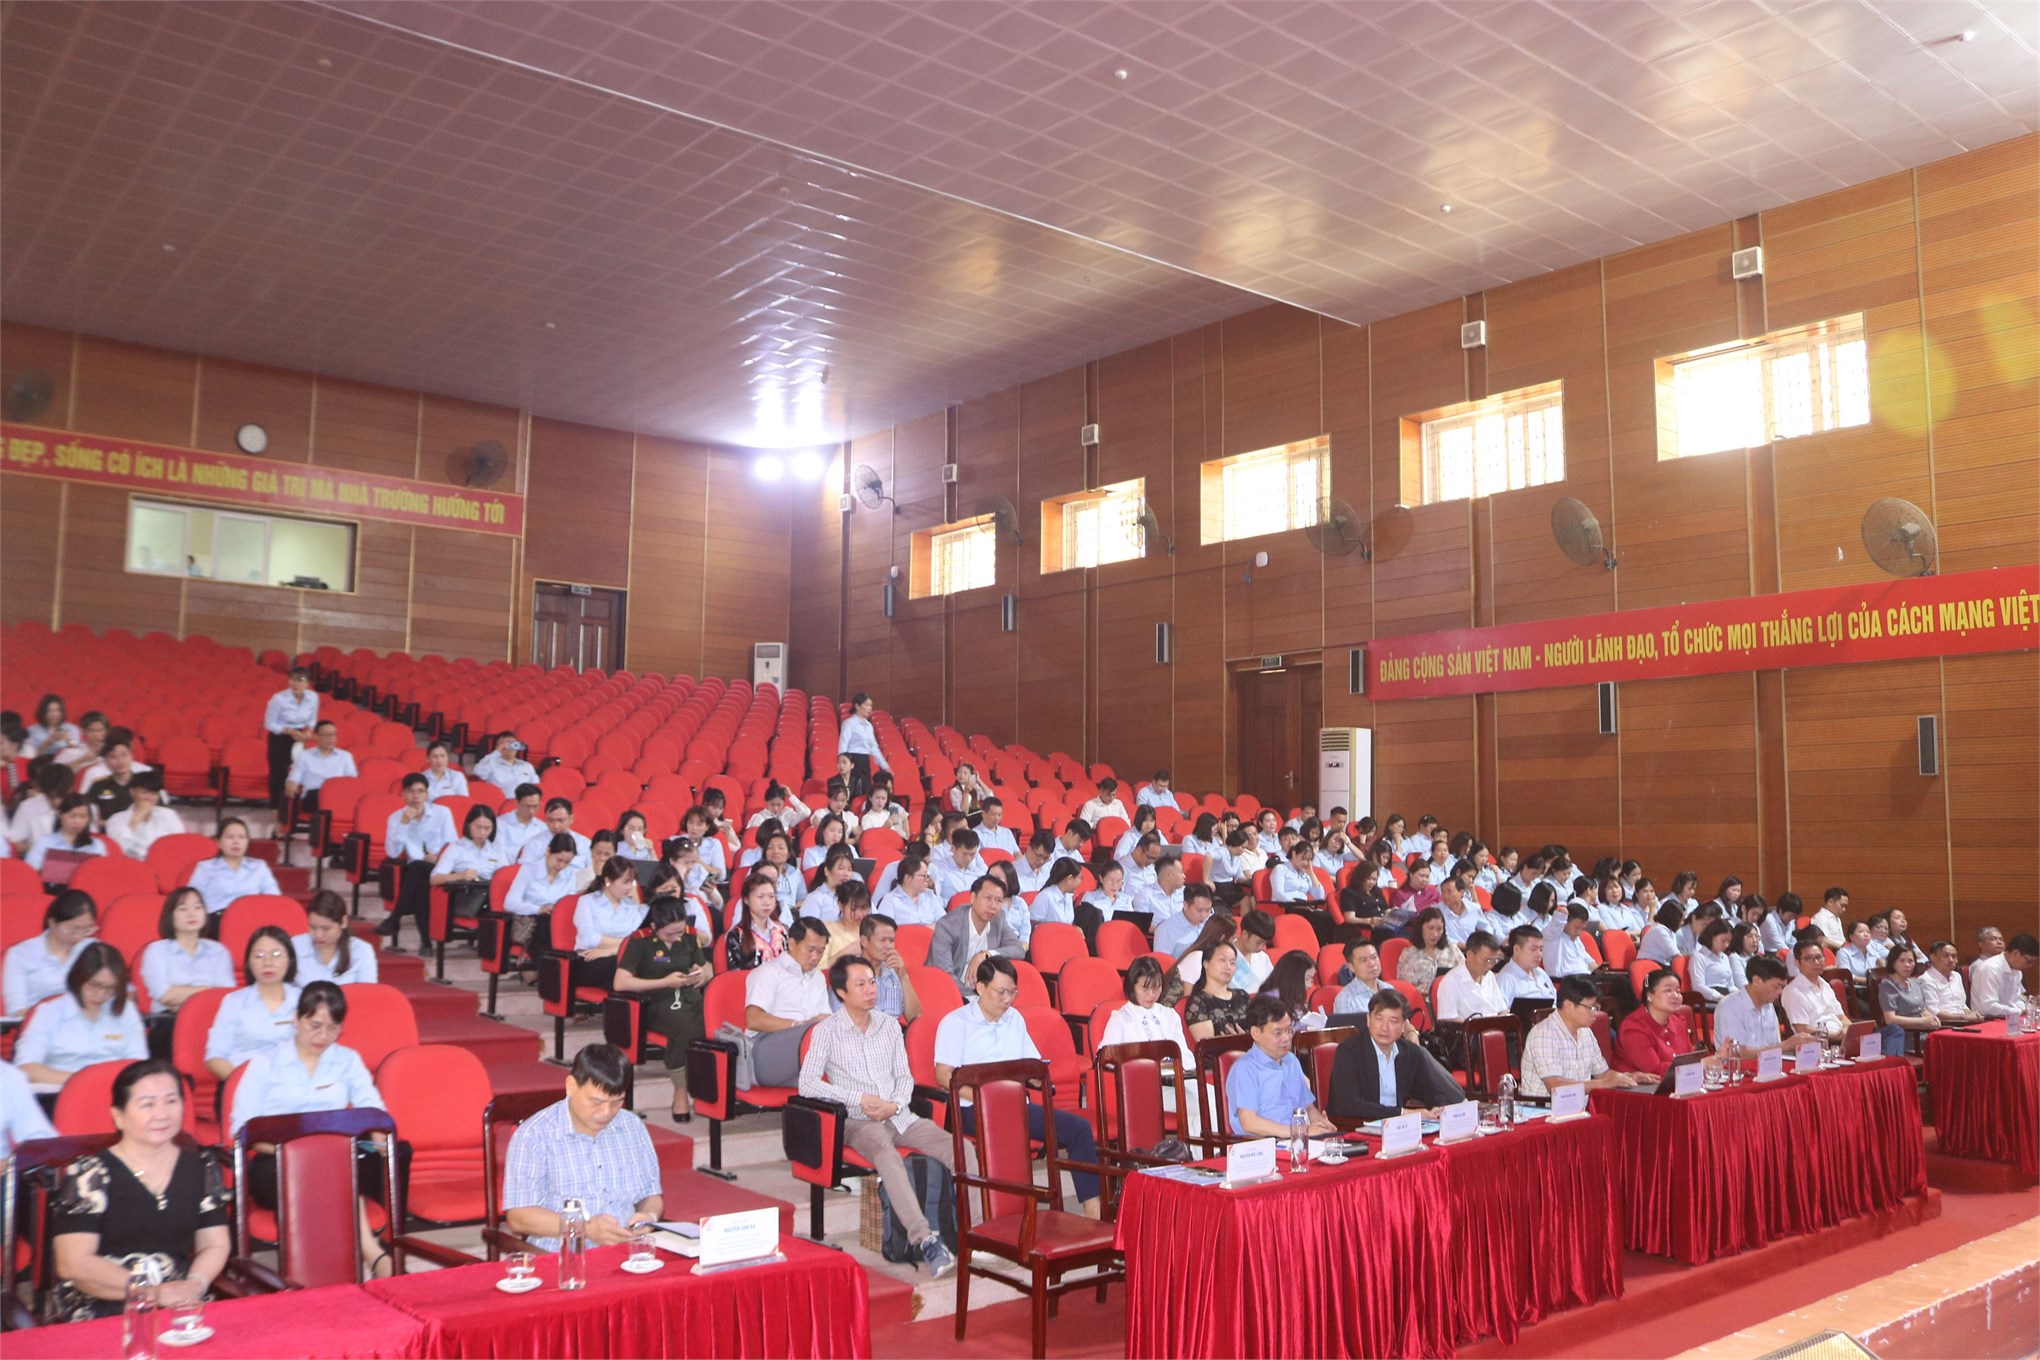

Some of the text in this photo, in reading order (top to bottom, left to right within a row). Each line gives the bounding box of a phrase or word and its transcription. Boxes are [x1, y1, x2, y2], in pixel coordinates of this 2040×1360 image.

[55, 438, 103, 471] SỐNG
[107, 449, 131, 475] CÓ
[135, 451, 163, 479] ÍCH
[167, 456, 188, 482] LÀ
[251, 468, 278, 494] GIÁ
[338, 481, 369, 506] NHÀ
[372, 486, 430, 514] TRƯỜNG
[432, 493, 481, 521] HƯỚNG
[484, 498, 505, 524] TỚI
[1379, 652, 1410, 683] ĐẢNG
[1413, 652, 1444, 684] CỘNG
[1447, 645, 1472, 676] SẢN
[1474, 645, 1499, 678] VIỆT
[1503, 645, 1532, 671] NAM
[1544, 635, 1585, 668] NGƯỜI
[1587, 633, 1623, 664] LÃNH
[1627, 632, 1658, 665] ĐẠO,
[1662, 620, 1680, 657] TỔ
[1684, 621, 1723, 655] CHỨC
[1727, 623, 1757, 655] MỌI
[1761, 608, 1813, 648] THẮNG
[1818, 611, 1843, 648] LỢI
[1847, 602, 1883, 640] CỦA
[1886, 601, 1934, 637] CÁCH
[1939, 599, 1995, 636] MẠNG
[1999, 589, 2039, 631] VIỆT
